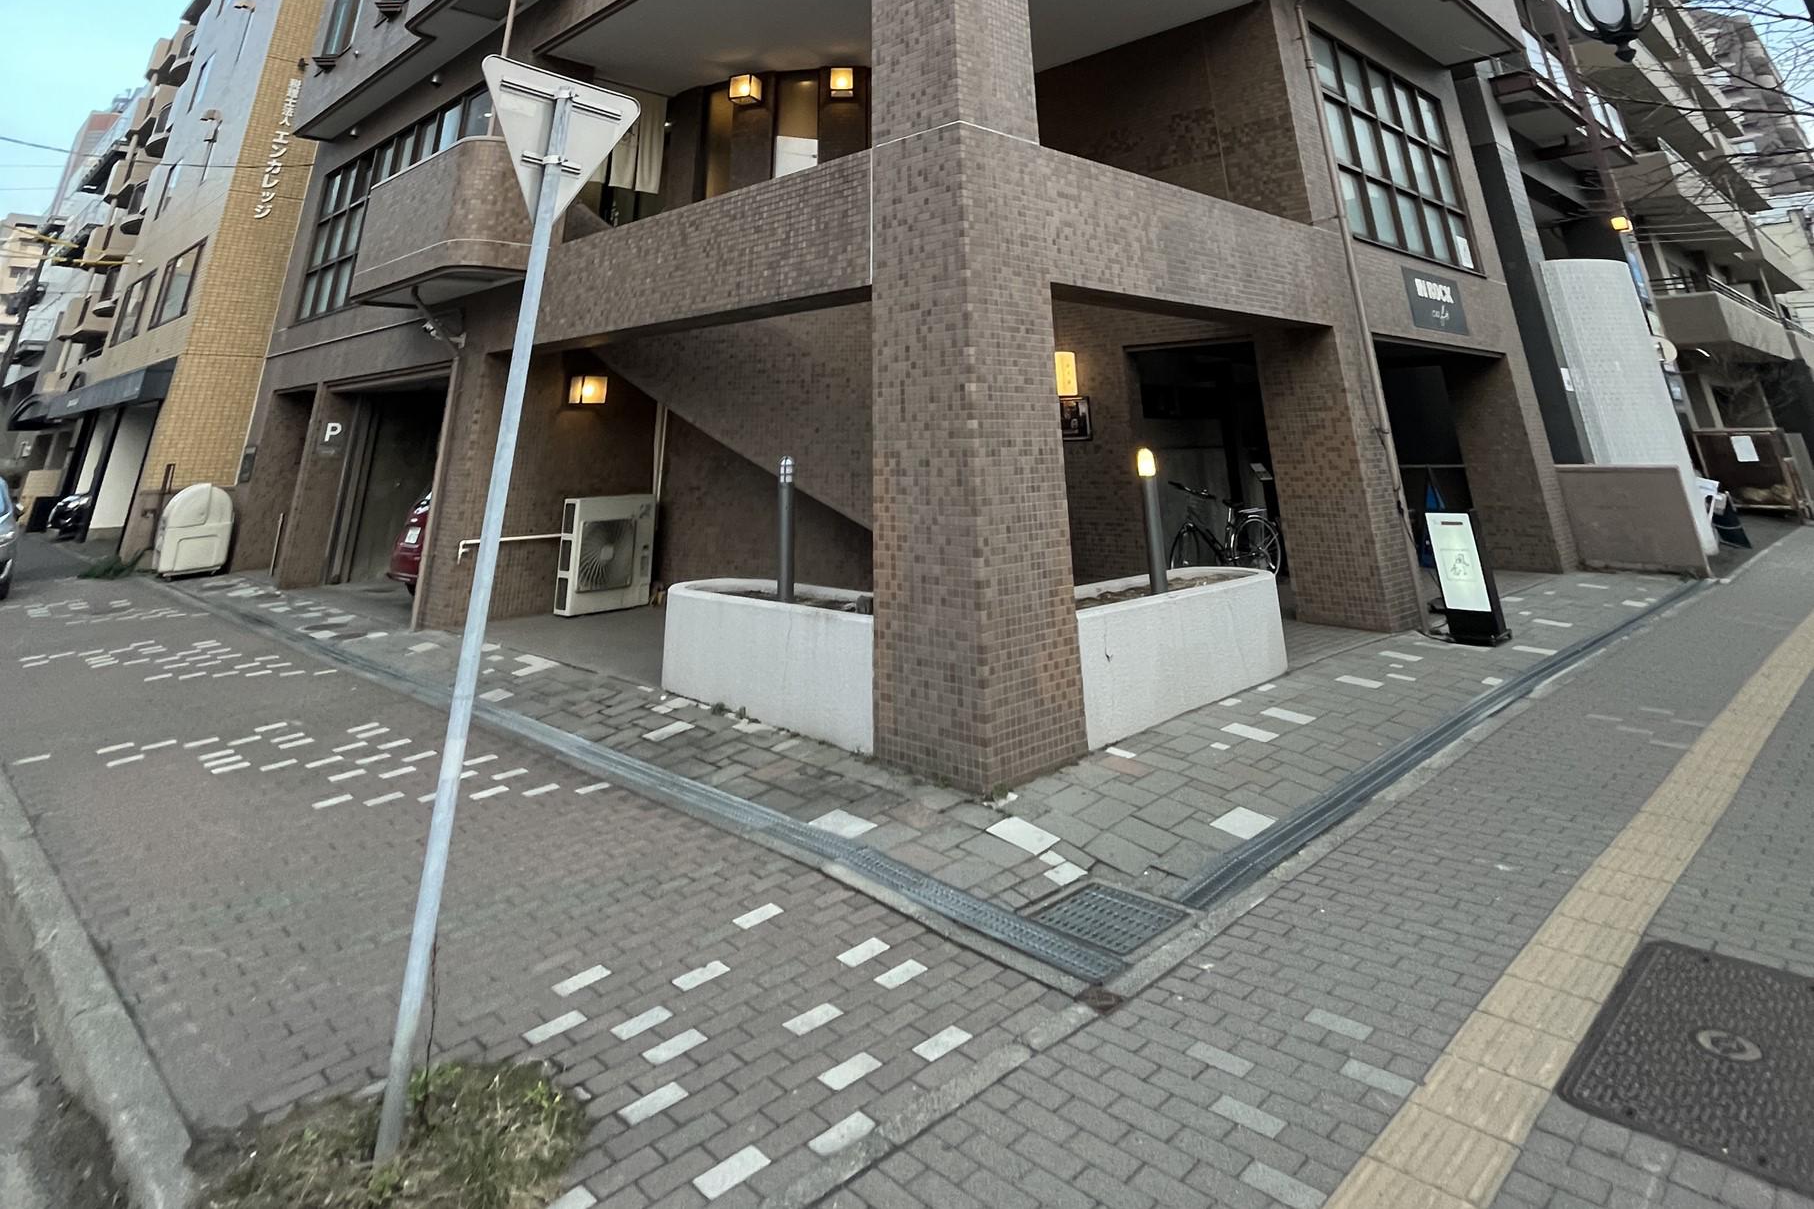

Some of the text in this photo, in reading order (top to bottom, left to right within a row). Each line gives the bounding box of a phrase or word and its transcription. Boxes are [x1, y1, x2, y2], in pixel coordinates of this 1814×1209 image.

[254, 130, 290, 220] エンカレッジ
[324, 422, 342, 442] P
